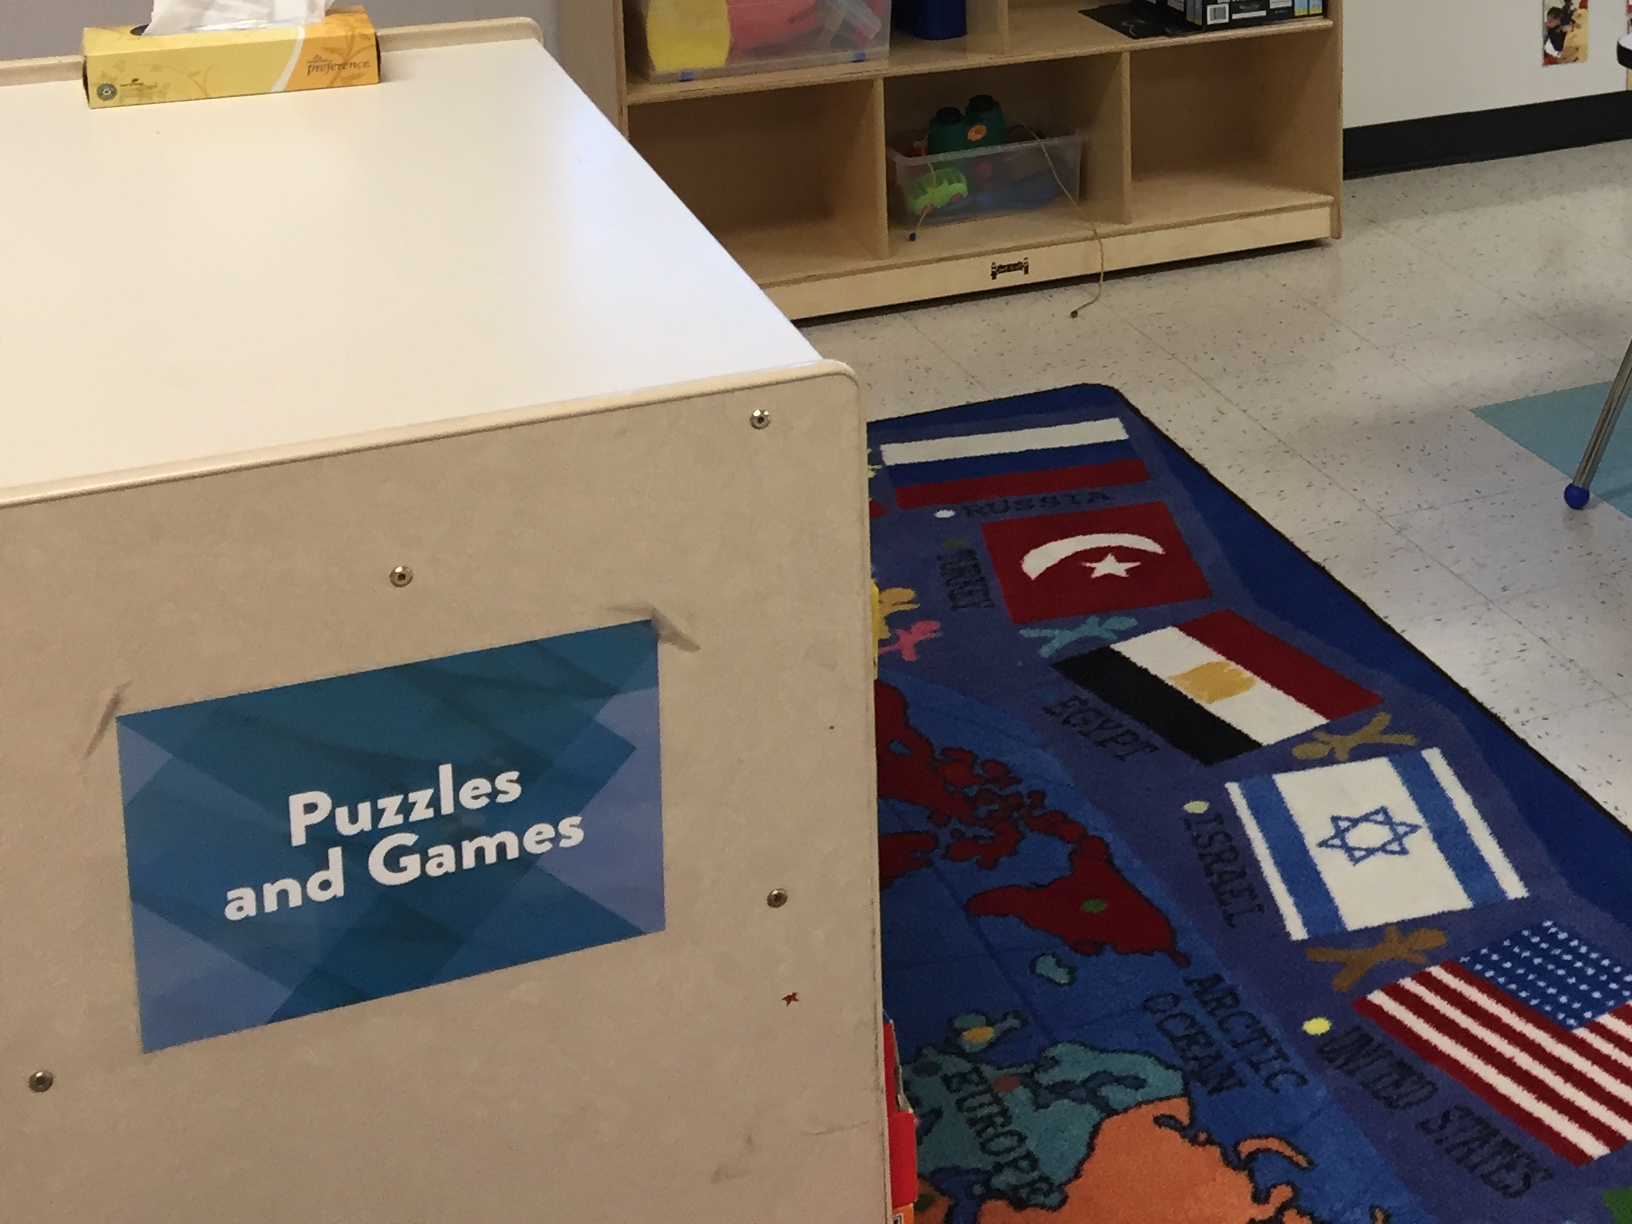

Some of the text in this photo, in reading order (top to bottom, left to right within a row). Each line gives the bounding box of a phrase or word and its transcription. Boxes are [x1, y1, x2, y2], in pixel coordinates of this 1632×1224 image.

[961, 490, 1111, 518] RUSSIA
[1042, 695, 1159, 762] EGYPT
[289, 763, 523, 847] Puzzles
[224, 814, 585, 921] and Games
[1182, 812, 1266, 929] ISRAEL
[1141, 992, 1247, 1096] OCEAN
[1184, 972, 1308, 1095] ARCTIC
[940, 1066, 1056, 1210] EUROPE
[1316, 1025, 1556, 1199] UNITED STATES
